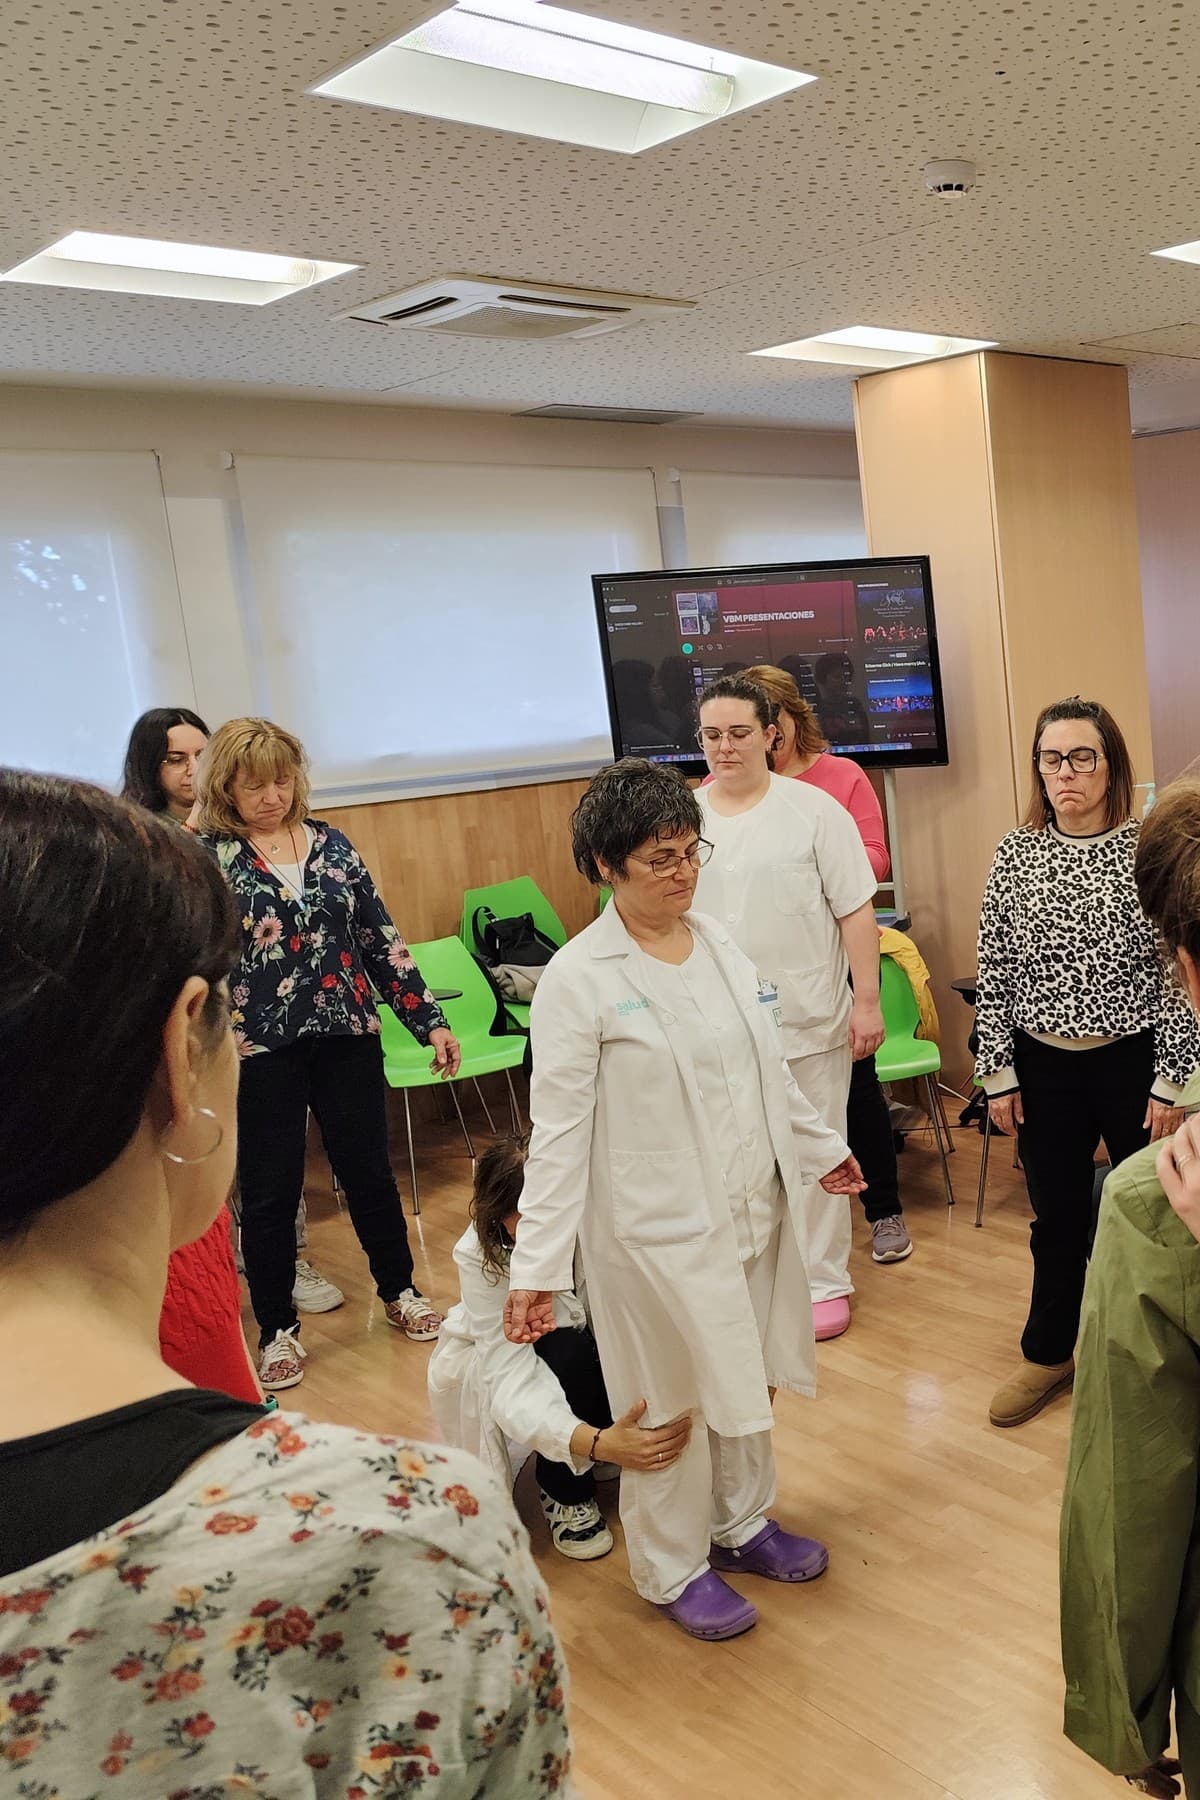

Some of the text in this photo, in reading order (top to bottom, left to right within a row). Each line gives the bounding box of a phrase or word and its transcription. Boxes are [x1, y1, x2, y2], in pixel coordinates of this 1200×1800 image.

[723, 610, 815, 623] VBM PRESENTACIONES
[616, 999, 650, 1010] salud
